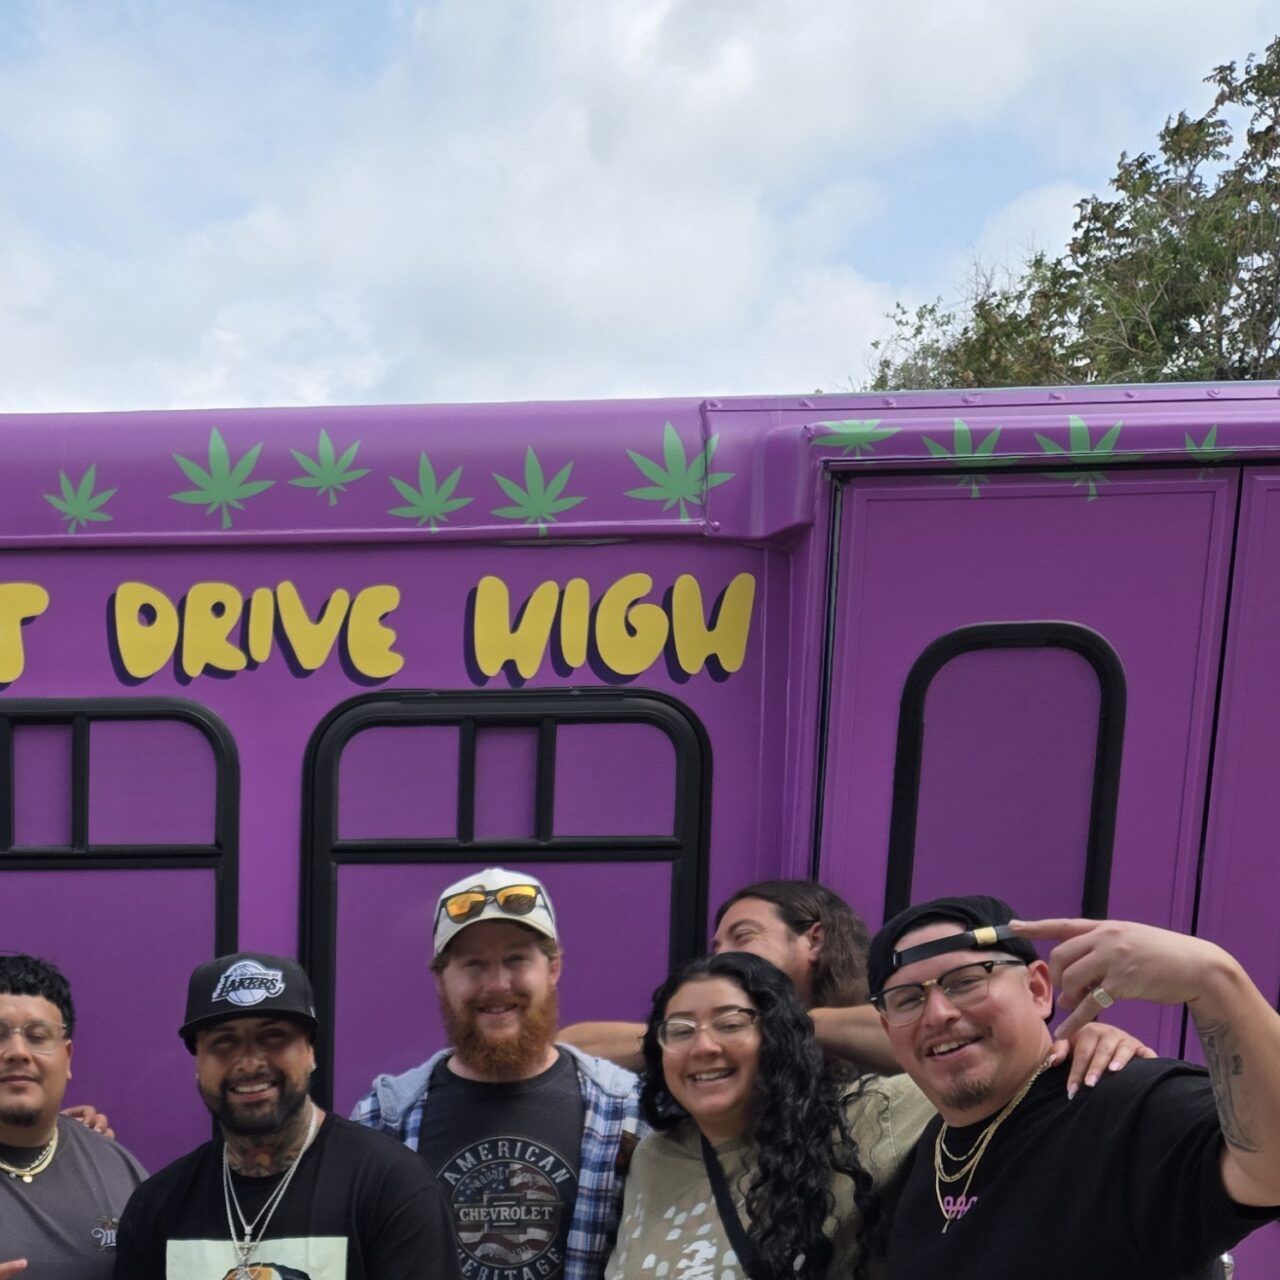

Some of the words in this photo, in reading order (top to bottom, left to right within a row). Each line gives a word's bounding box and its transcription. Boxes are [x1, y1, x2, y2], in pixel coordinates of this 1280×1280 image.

[114, 581, 403, 678] DRIVE
[474, 573, 756, 679] HIGH
[212, 974, 283, 999] LAKERS
[443, 1141, 570, 1186] AMERICAN
[459, 1206, 553, 1221] CHEVROLET
